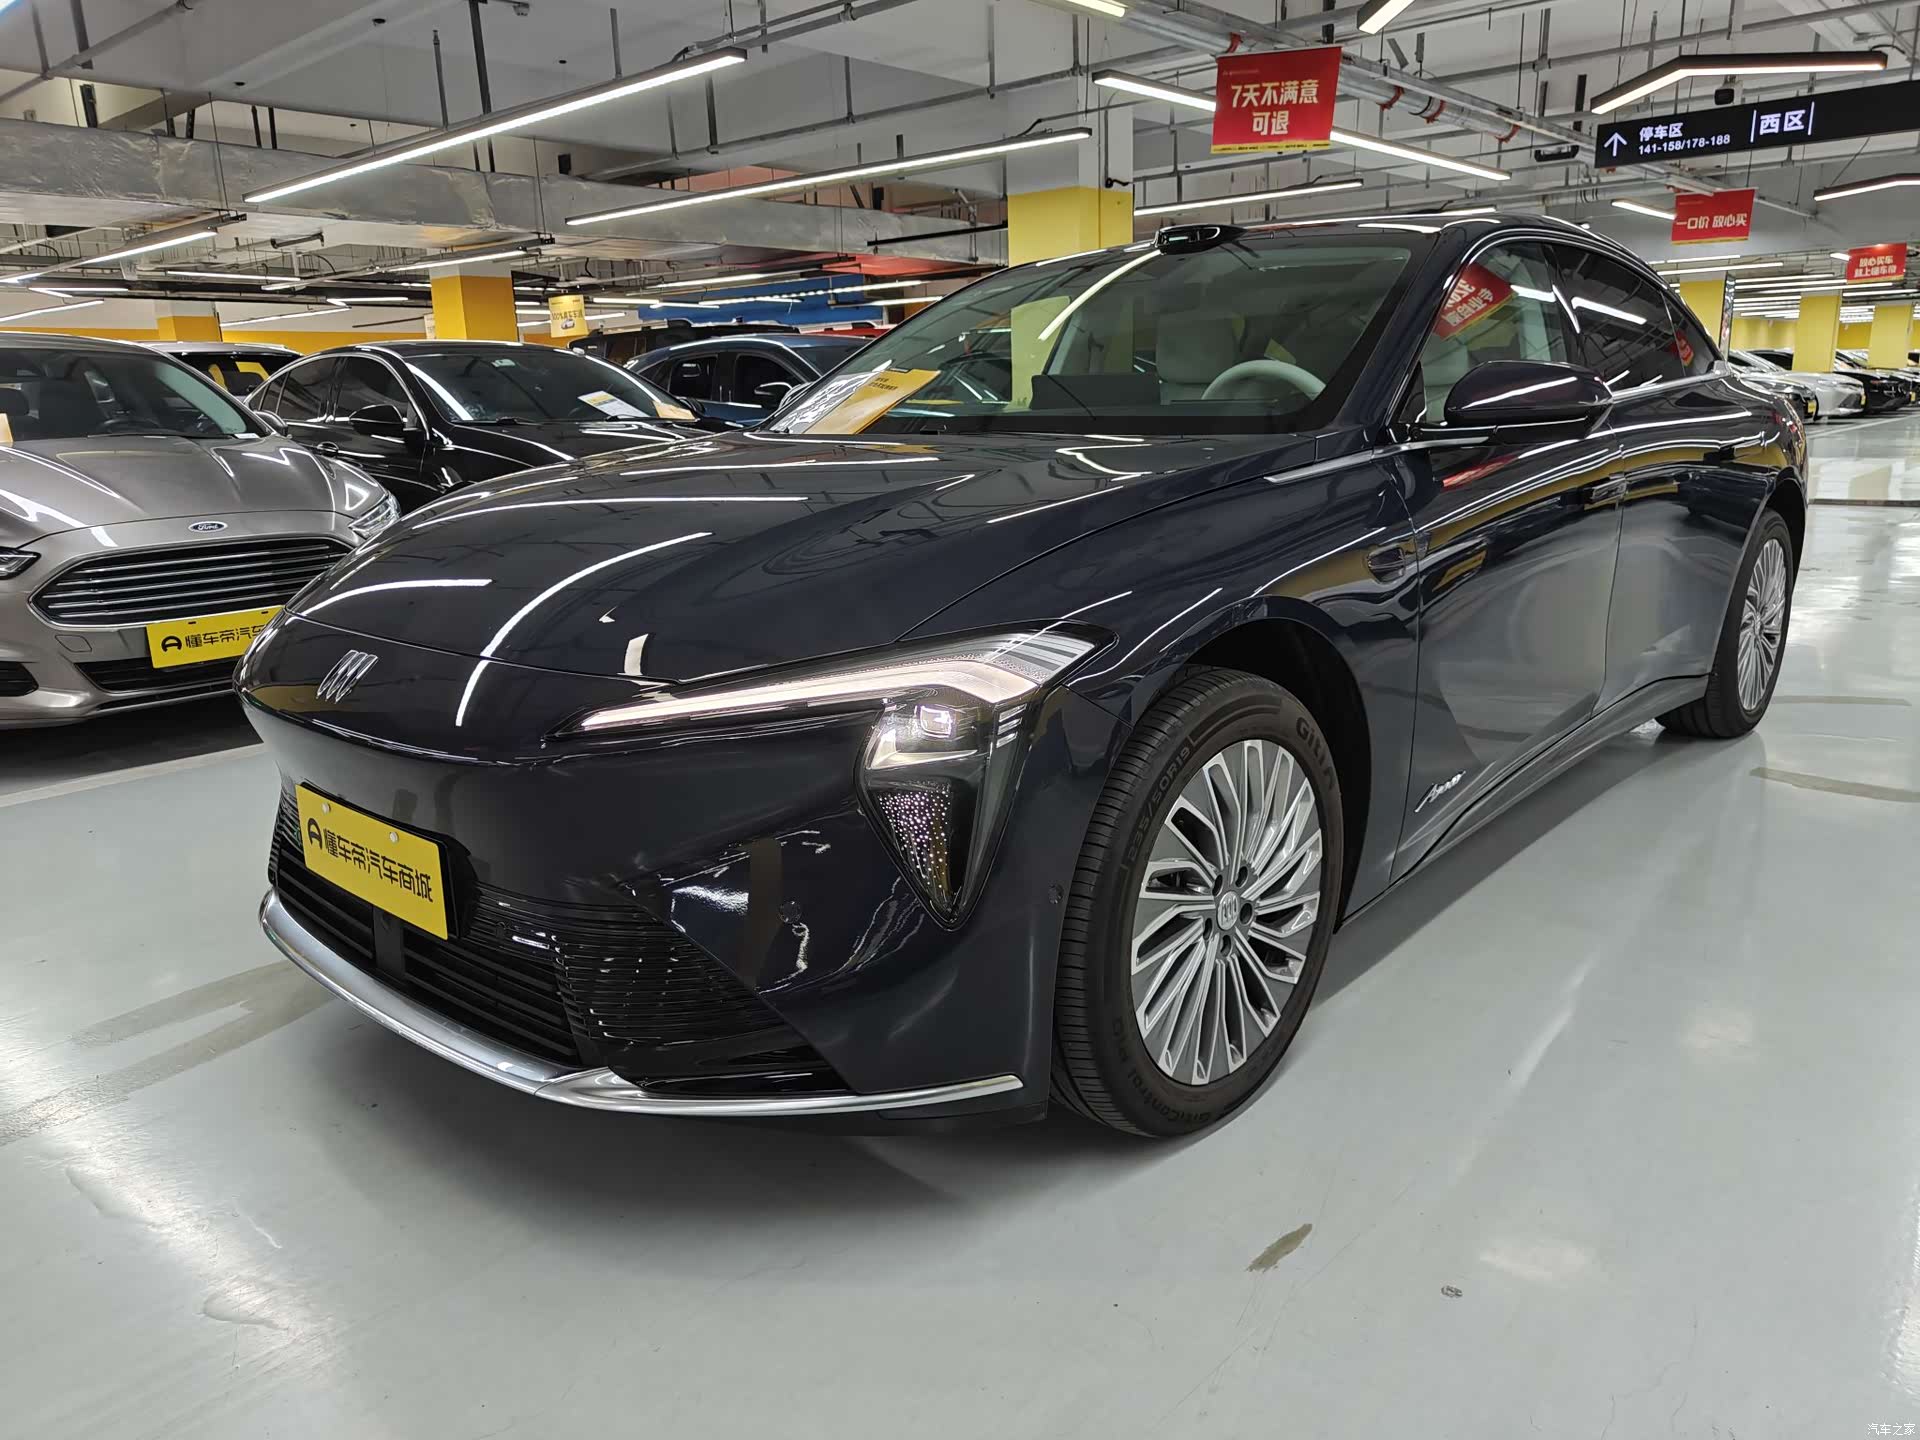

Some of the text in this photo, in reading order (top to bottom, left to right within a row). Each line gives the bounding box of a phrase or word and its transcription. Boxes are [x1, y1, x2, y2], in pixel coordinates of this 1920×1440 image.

[1231, 79, 1319, 108] 7天不满意
[1252, 111, 1290, 136] 可退
[1639, 122, 1684, 142] 停车区
[1759, 110, 1806, 135] 西区
[1638, 134, 1731, 155] 141-158/178-188
[1676, 213, 1748, 230] 一口价 放心买
[324, 828, 434, 903] 懂车帝汽车商城
